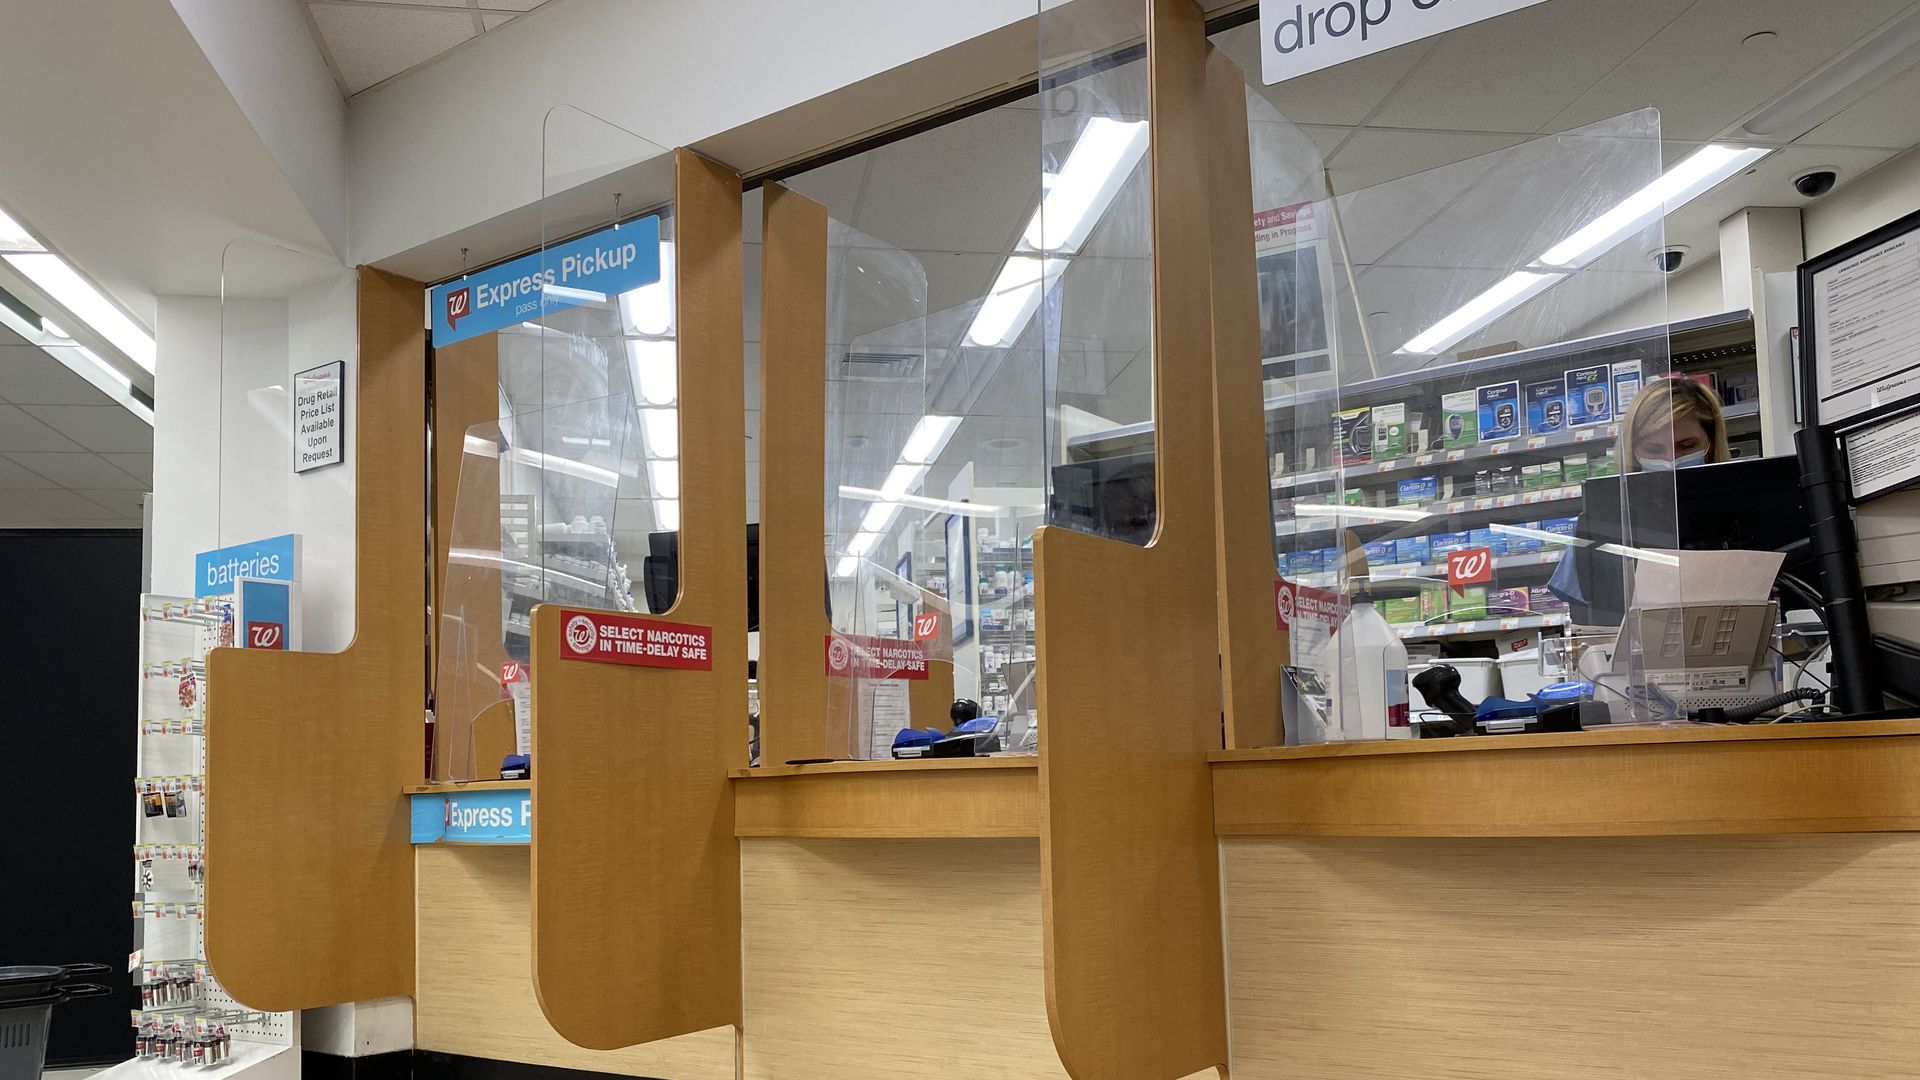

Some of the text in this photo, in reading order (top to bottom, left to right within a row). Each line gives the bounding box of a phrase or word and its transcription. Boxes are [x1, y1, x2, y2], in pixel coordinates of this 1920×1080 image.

[1274, 0, 1392, 54] drop
[476, 242, 636, 309] Express Pickup
[515, 301, 537, 317] pass
[298, 387, 338, 407] Drug Retail
[301, 402, 335, 420] Price List
[301, 418, 334, 434] Available
[308, 435, 327, 448] Upon
[303, 448, 332, 463] Request
[208, 551, 280, 587] batteries
[600, 625, 705, 647] SELECT NARCOTICS
[600, 640, 707, 661] IN TIME-DELAY SAFE
[851, 646, 923, 660] SELECT NARCOTICS
[851, 658, 925, 671] IN TIME-DELAY SAFE
[452, 802, 513, 832] Express
